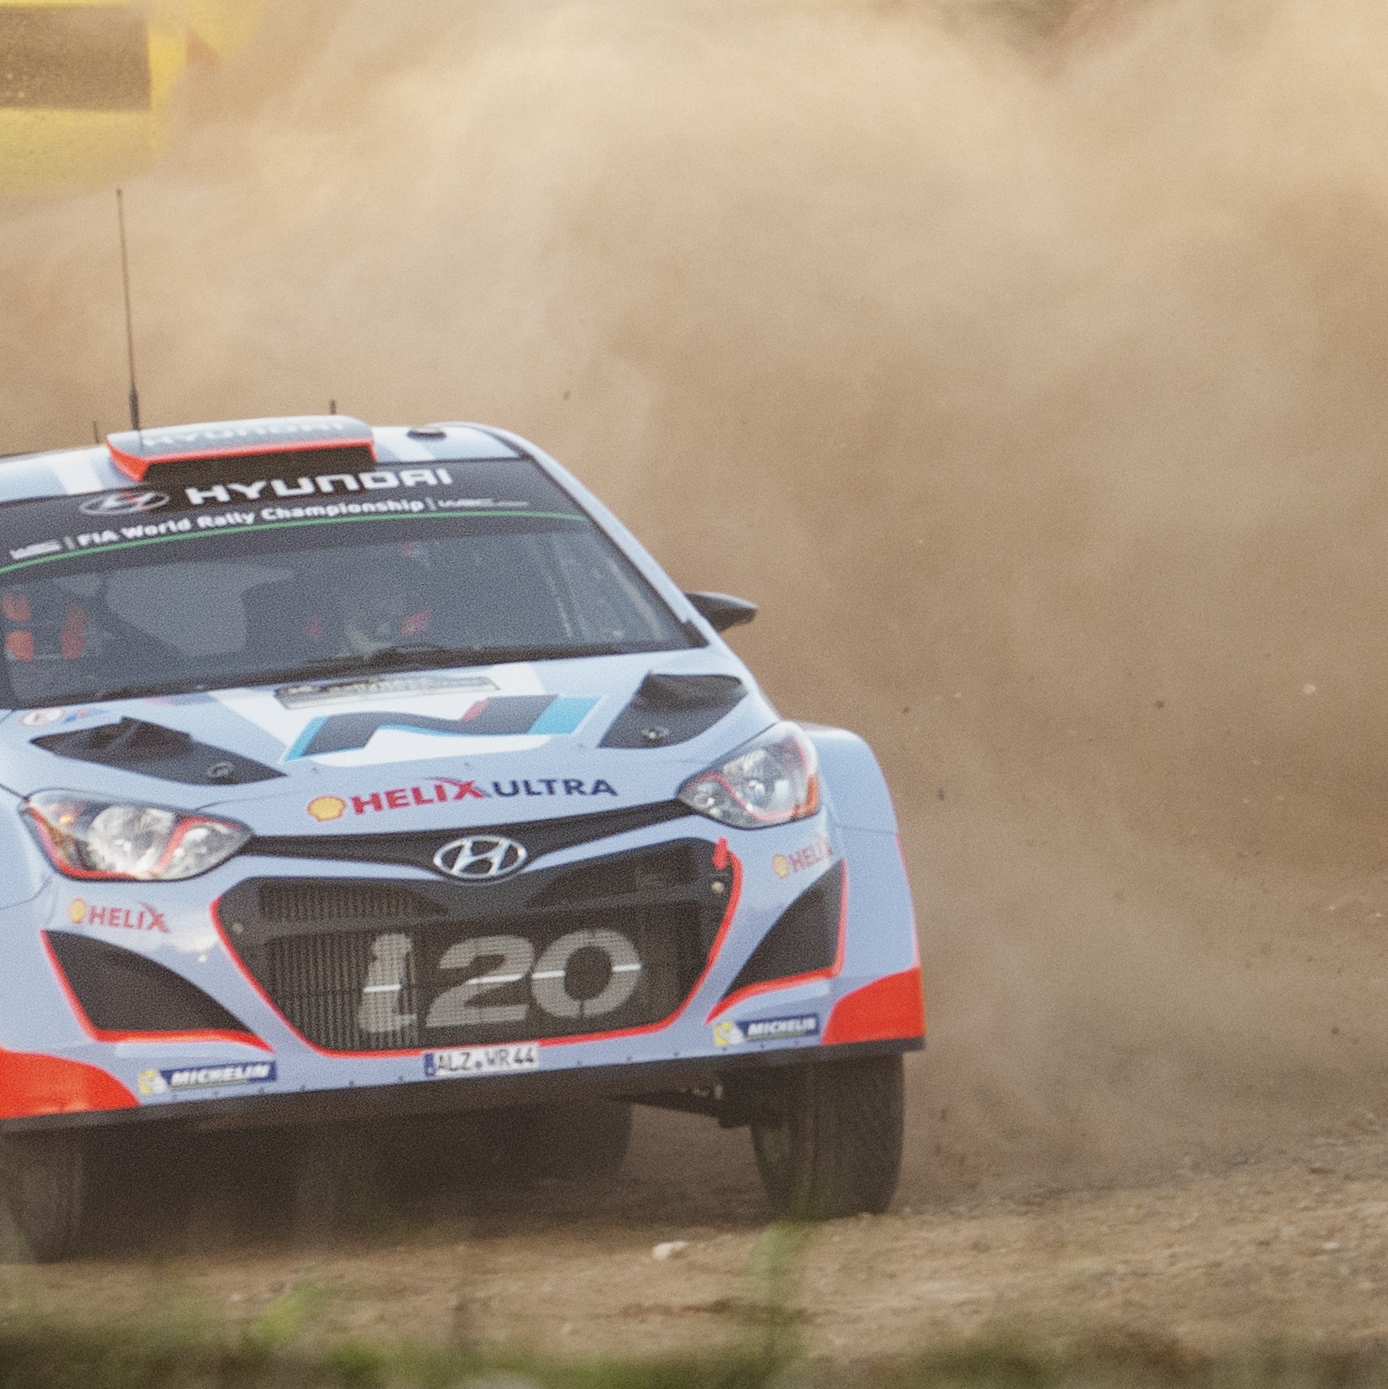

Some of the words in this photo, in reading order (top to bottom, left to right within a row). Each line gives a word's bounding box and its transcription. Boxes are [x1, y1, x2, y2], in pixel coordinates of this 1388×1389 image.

[185, 468, 454, 507] HYUNDAI
[76, 528, 120, 548] FIA
[121, 515, 194, 540] World
[196, 510, 257, 532] Rally
[261, 497, 425, 521] Championship
[350, 776, 492, 816] HELIX
[491, 777, 619, 797] ULTRA
[88, 899, 169, 934] HELIX
[747, 1017, 817, 1036] MICHELIN
[170, 1064, 271, 1087] MICHELIN
